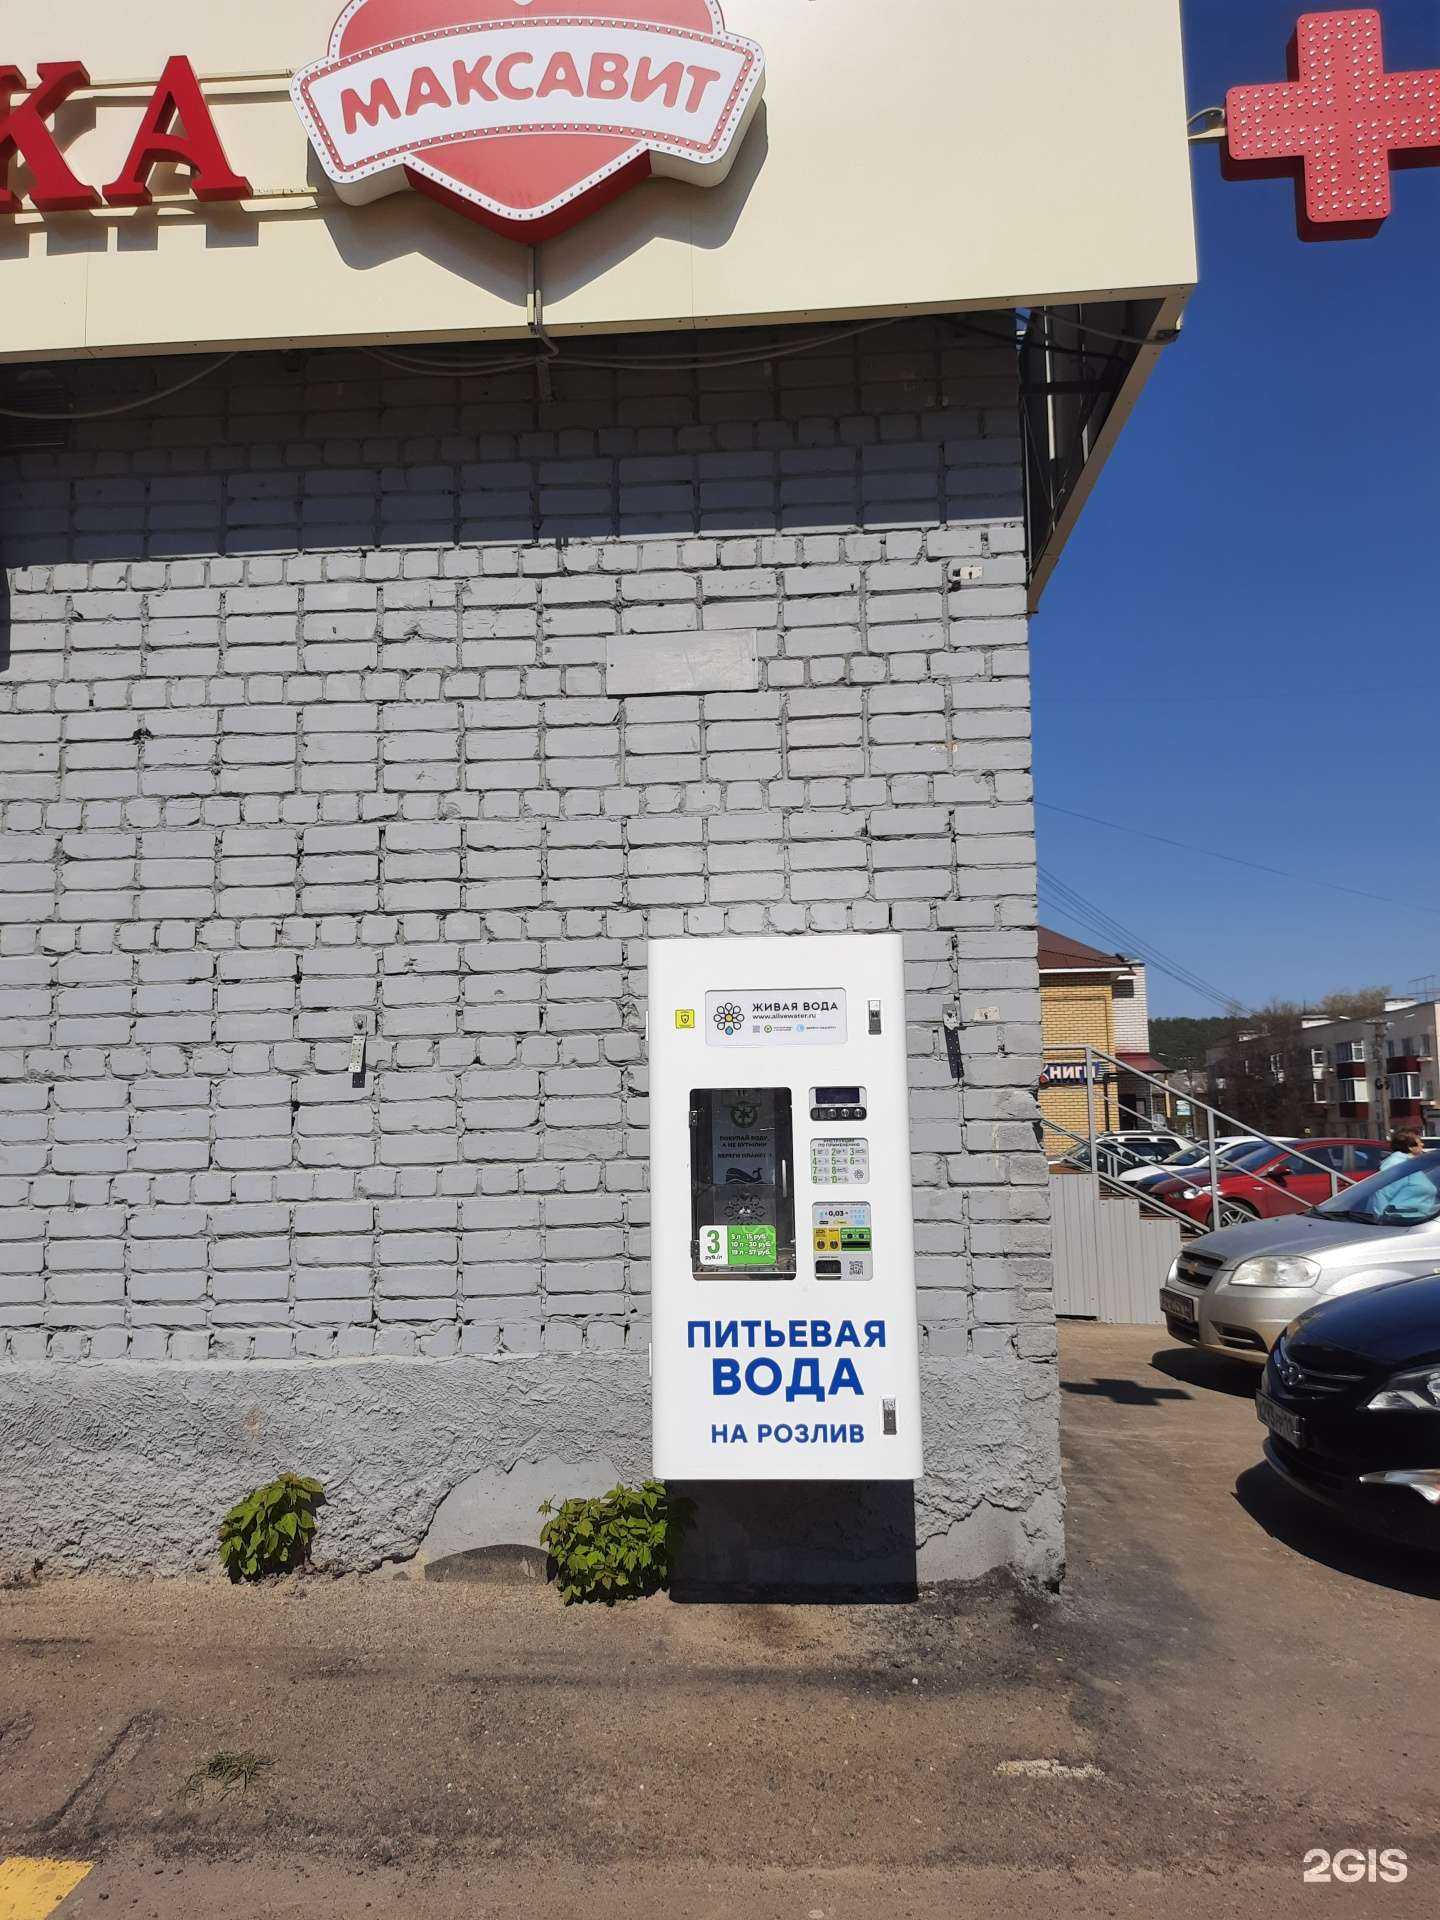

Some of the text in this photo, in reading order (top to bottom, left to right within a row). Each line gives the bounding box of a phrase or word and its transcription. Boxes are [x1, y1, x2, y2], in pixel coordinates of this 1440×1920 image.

[340, 51, 721, 135] МАКСАВИТ
[752, 1001, 839, 1012] ЖИВАЯ ВОДА
[707, 1229, 720, 1254] 3
[687, 1319, 887, 1348] ПИТЬЕВАЯ
[712, 1357, 865, 1402] ВОДА
[711, 1423, 865, 1443] НА РОЗЛИВ
